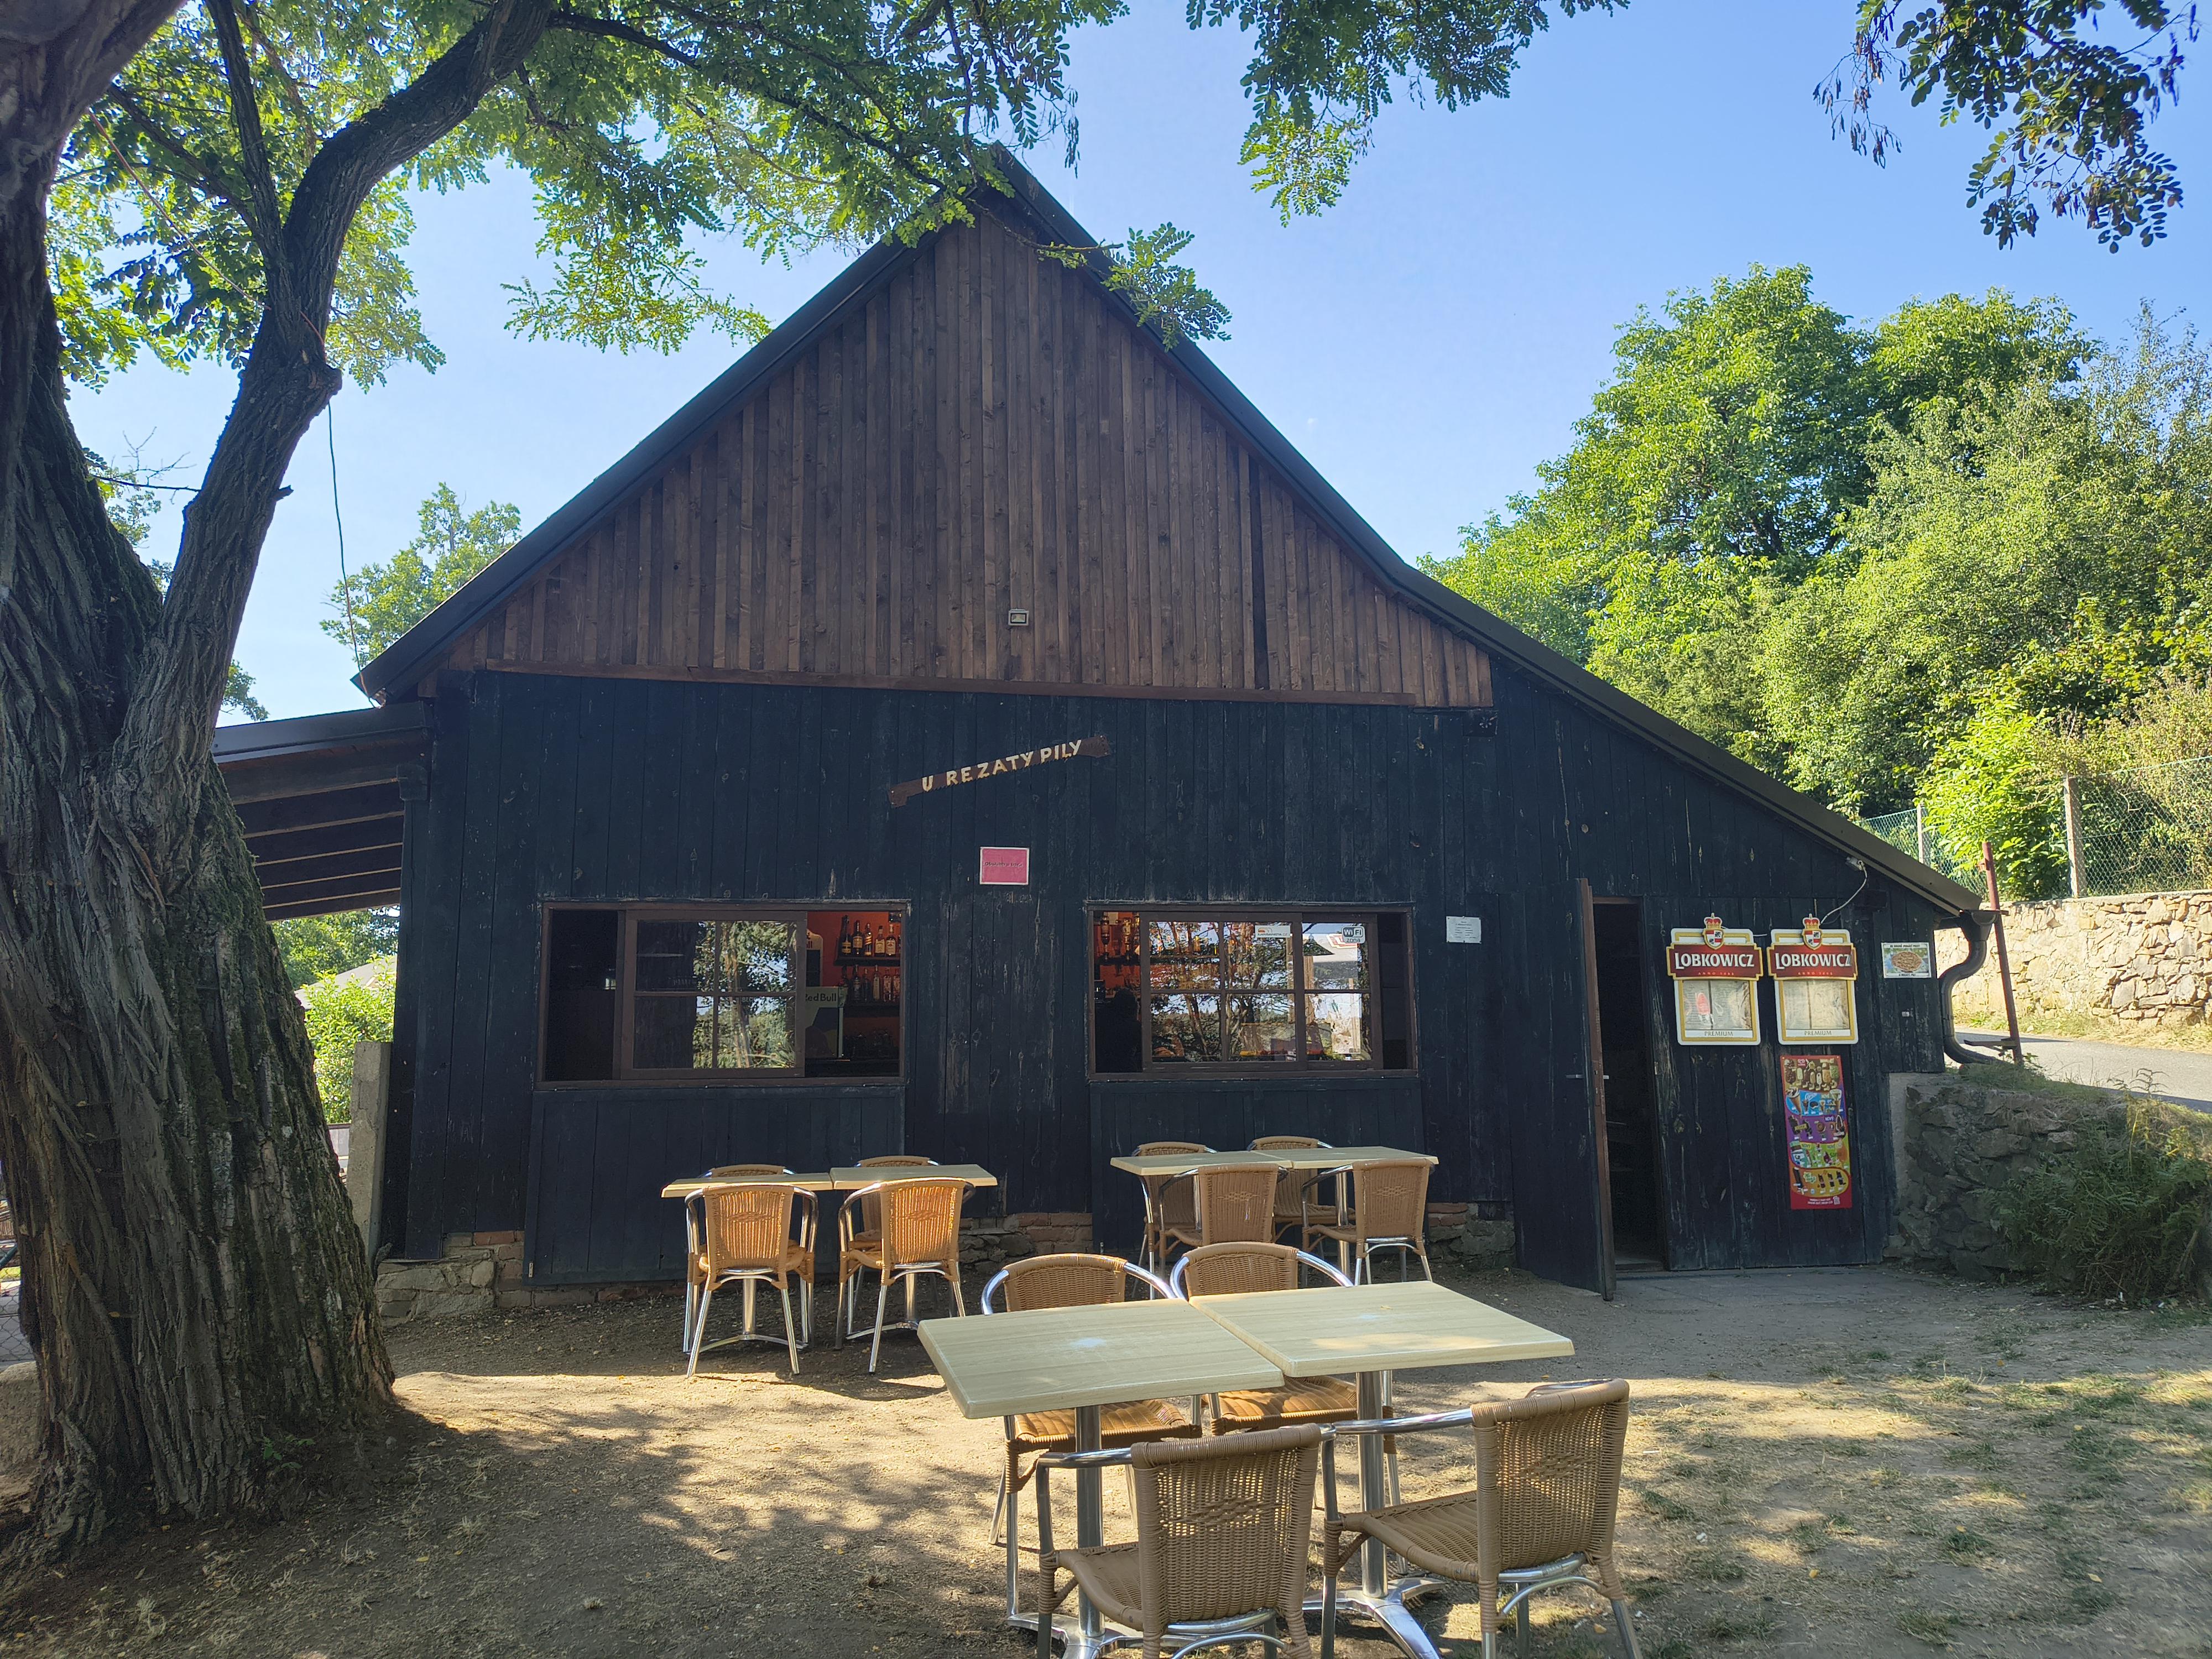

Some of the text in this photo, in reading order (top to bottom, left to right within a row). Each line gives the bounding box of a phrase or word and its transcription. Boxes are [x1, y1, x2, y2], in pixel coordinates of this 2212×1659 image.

[921, 775, 933, 792] U
[1040, 739, 1082, 764] PILY
[1674, 952, 1755, 969] LOBKOWICZ
[1775, 952, 1853, 969] LOBKOWICZ
